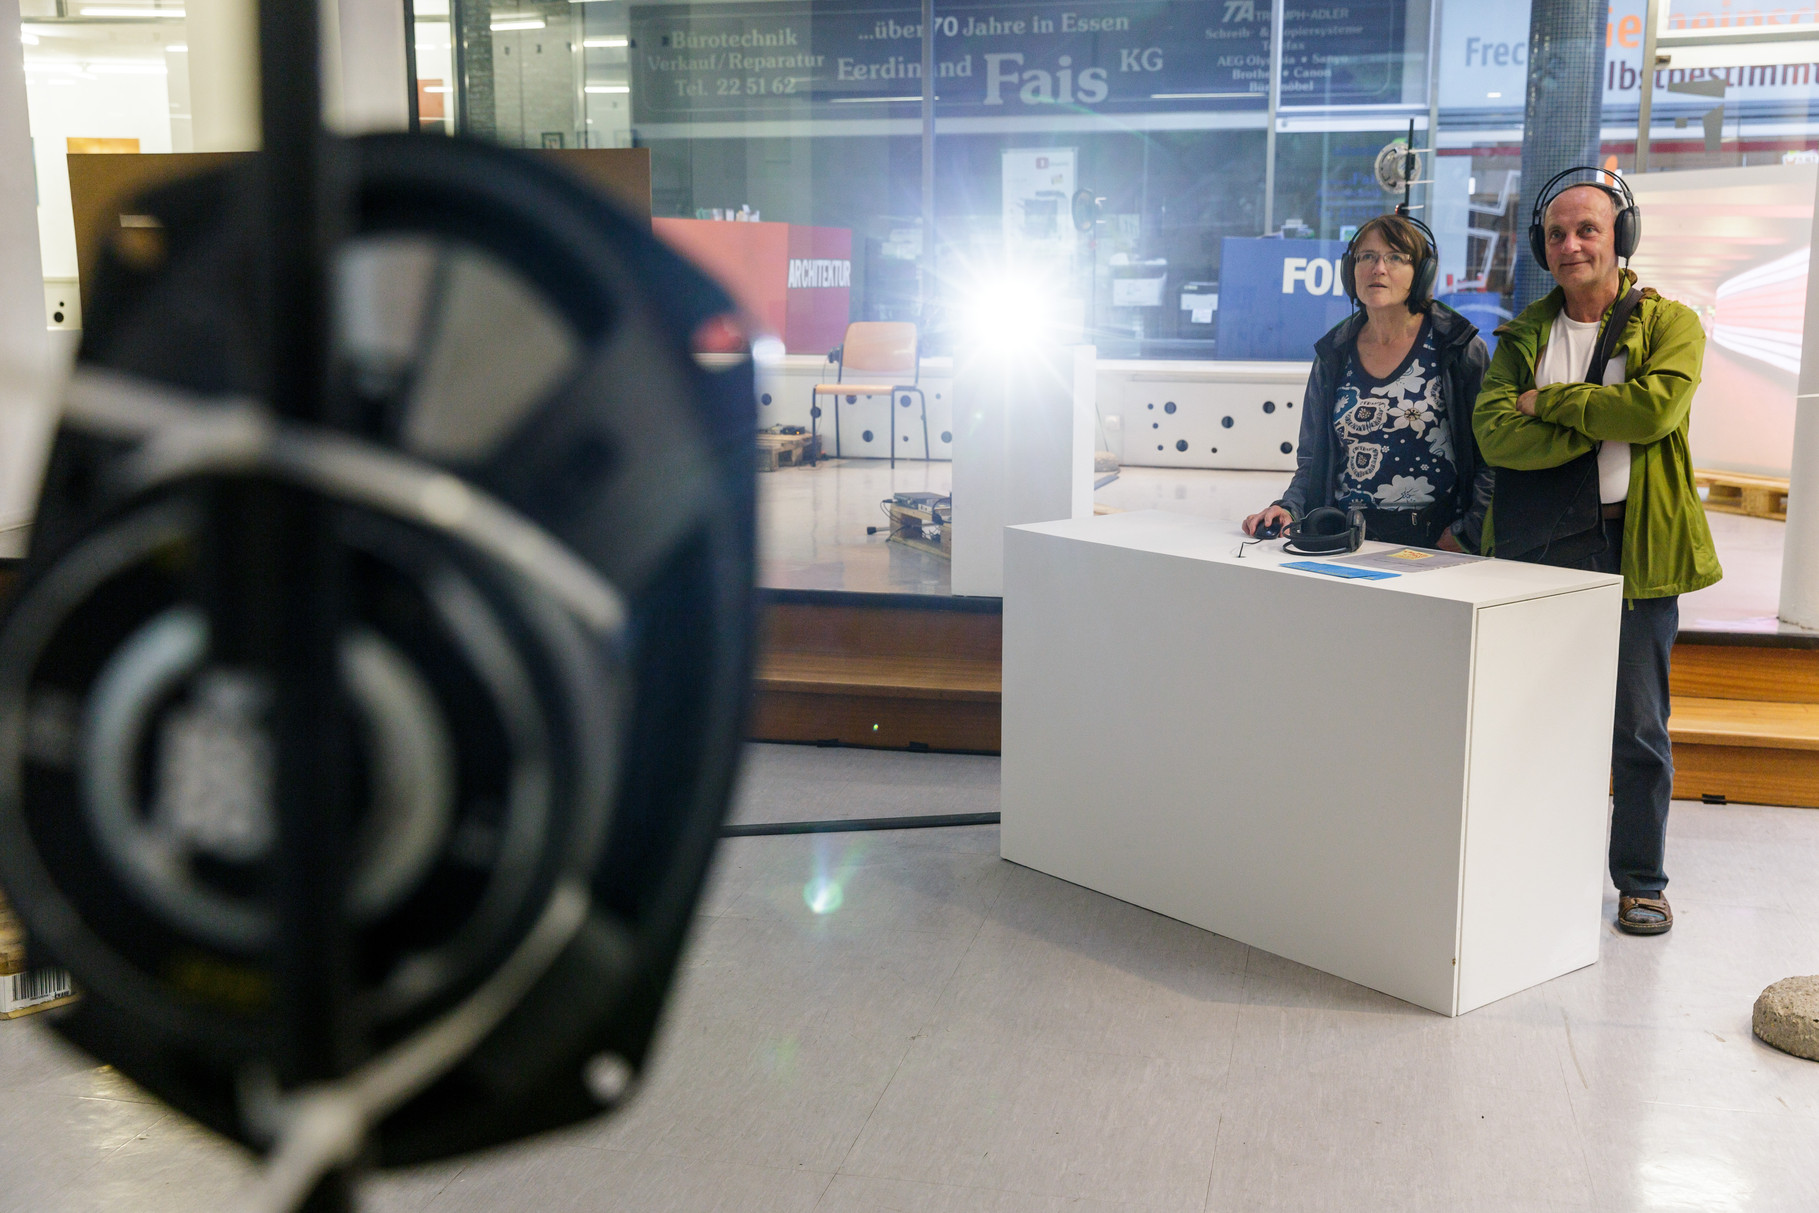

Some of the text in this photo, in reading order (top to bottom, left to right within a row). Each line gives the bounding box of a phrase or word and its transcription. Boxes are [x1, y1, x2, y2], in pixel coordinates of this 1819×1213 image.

[962, 16, 1026, 36] Jahre
[1032, 16, 1054, 34] in
[1061, 12, 1130, 33] Essen
[1256, 8, 1349, 22] TRMPH-ADLER
[671, 28, 798, 50] Bürotechnik
[1217, 55, 1244, 68] AEG
[983, 53, 1109, 105] Fais
[1119, 48, 1164, 72] KG
[1232, 67, 1332, 80] Brothe Canon
[675, 77, 797, 97] Tel. 22 51 62
[788, 259, 851, 288] ARCHITEKTUR
